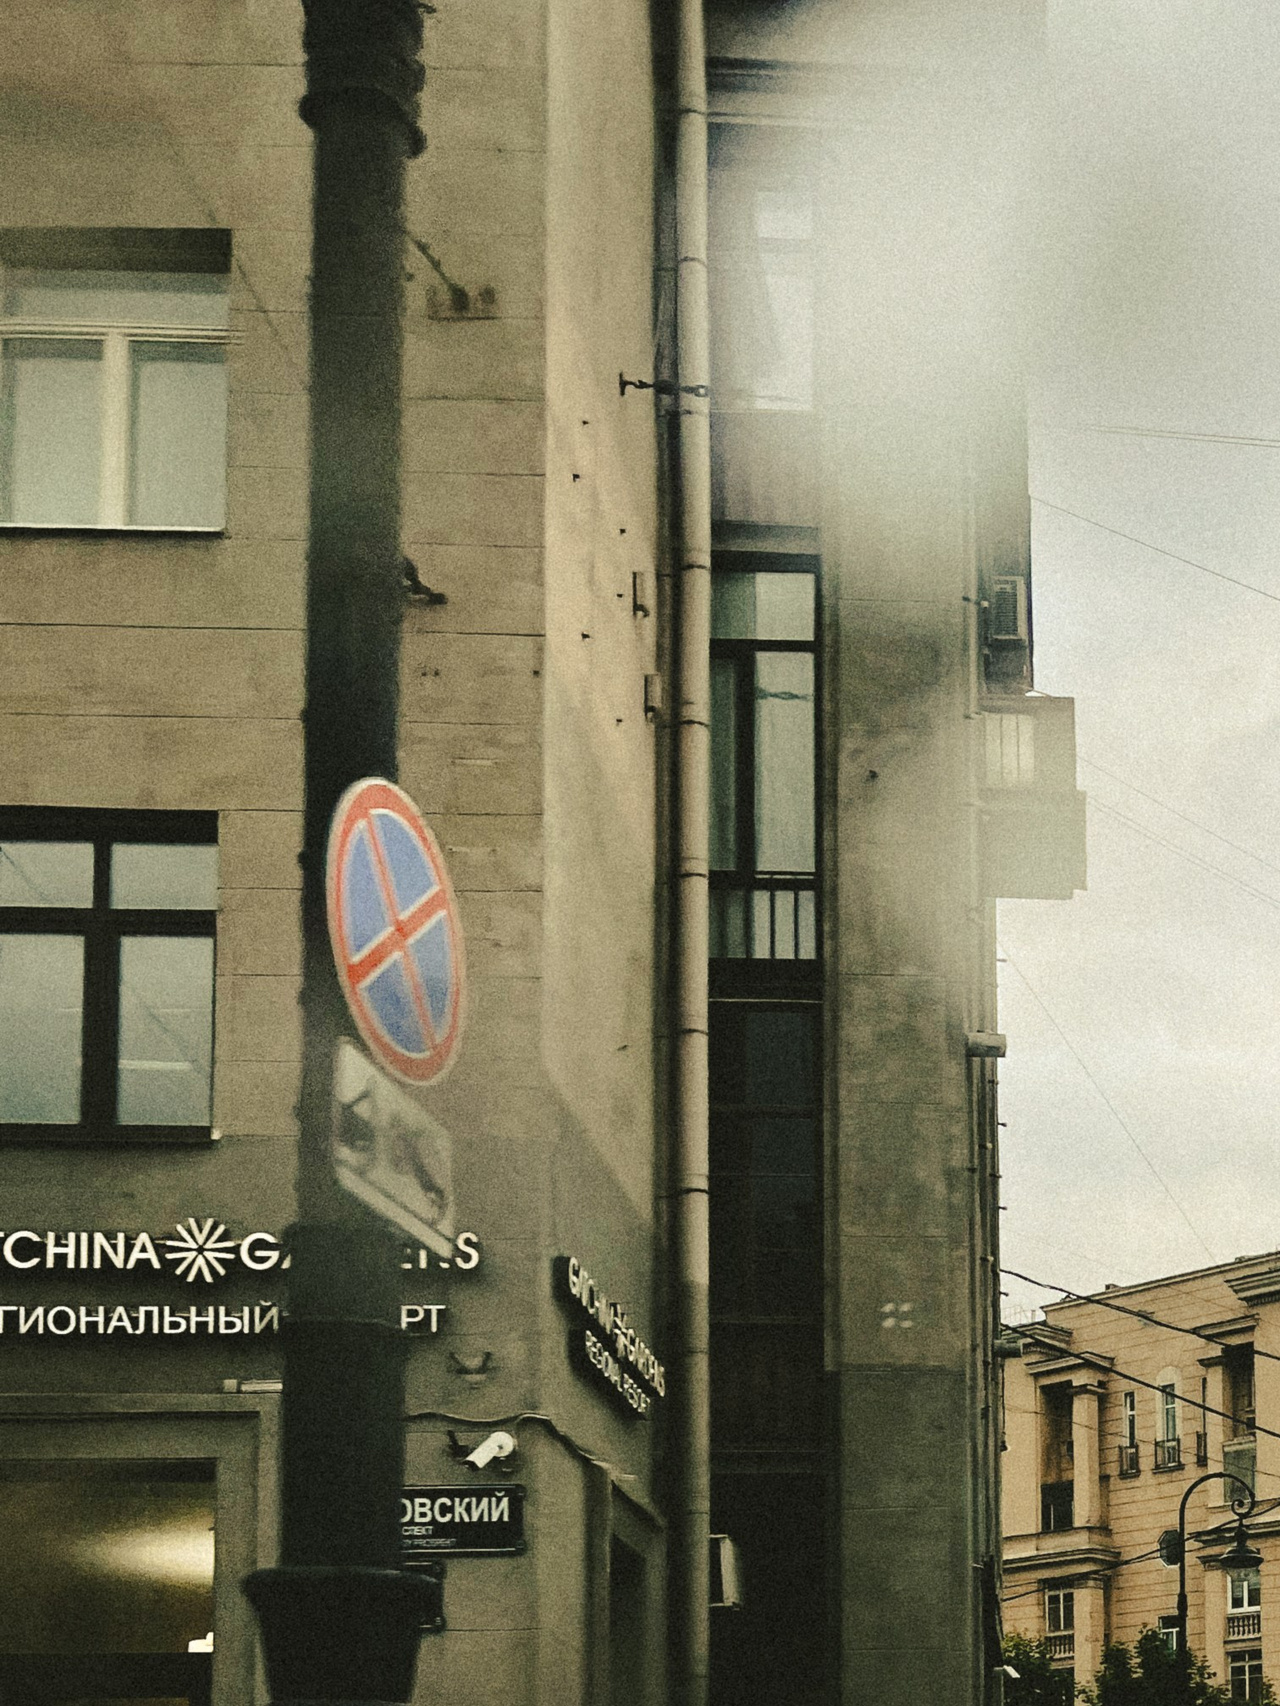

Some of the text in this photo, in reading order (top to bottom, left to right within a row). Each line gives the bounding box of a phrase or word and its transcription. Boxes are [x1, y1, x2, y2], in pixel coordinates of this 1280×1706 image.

[0, 1231, 160, 1269] CHINA
[0, 1300, 279, 1335] ГИОНАЛЬНЫЙ
[401, 1491, 510, 1523] ОВСКИЙ
